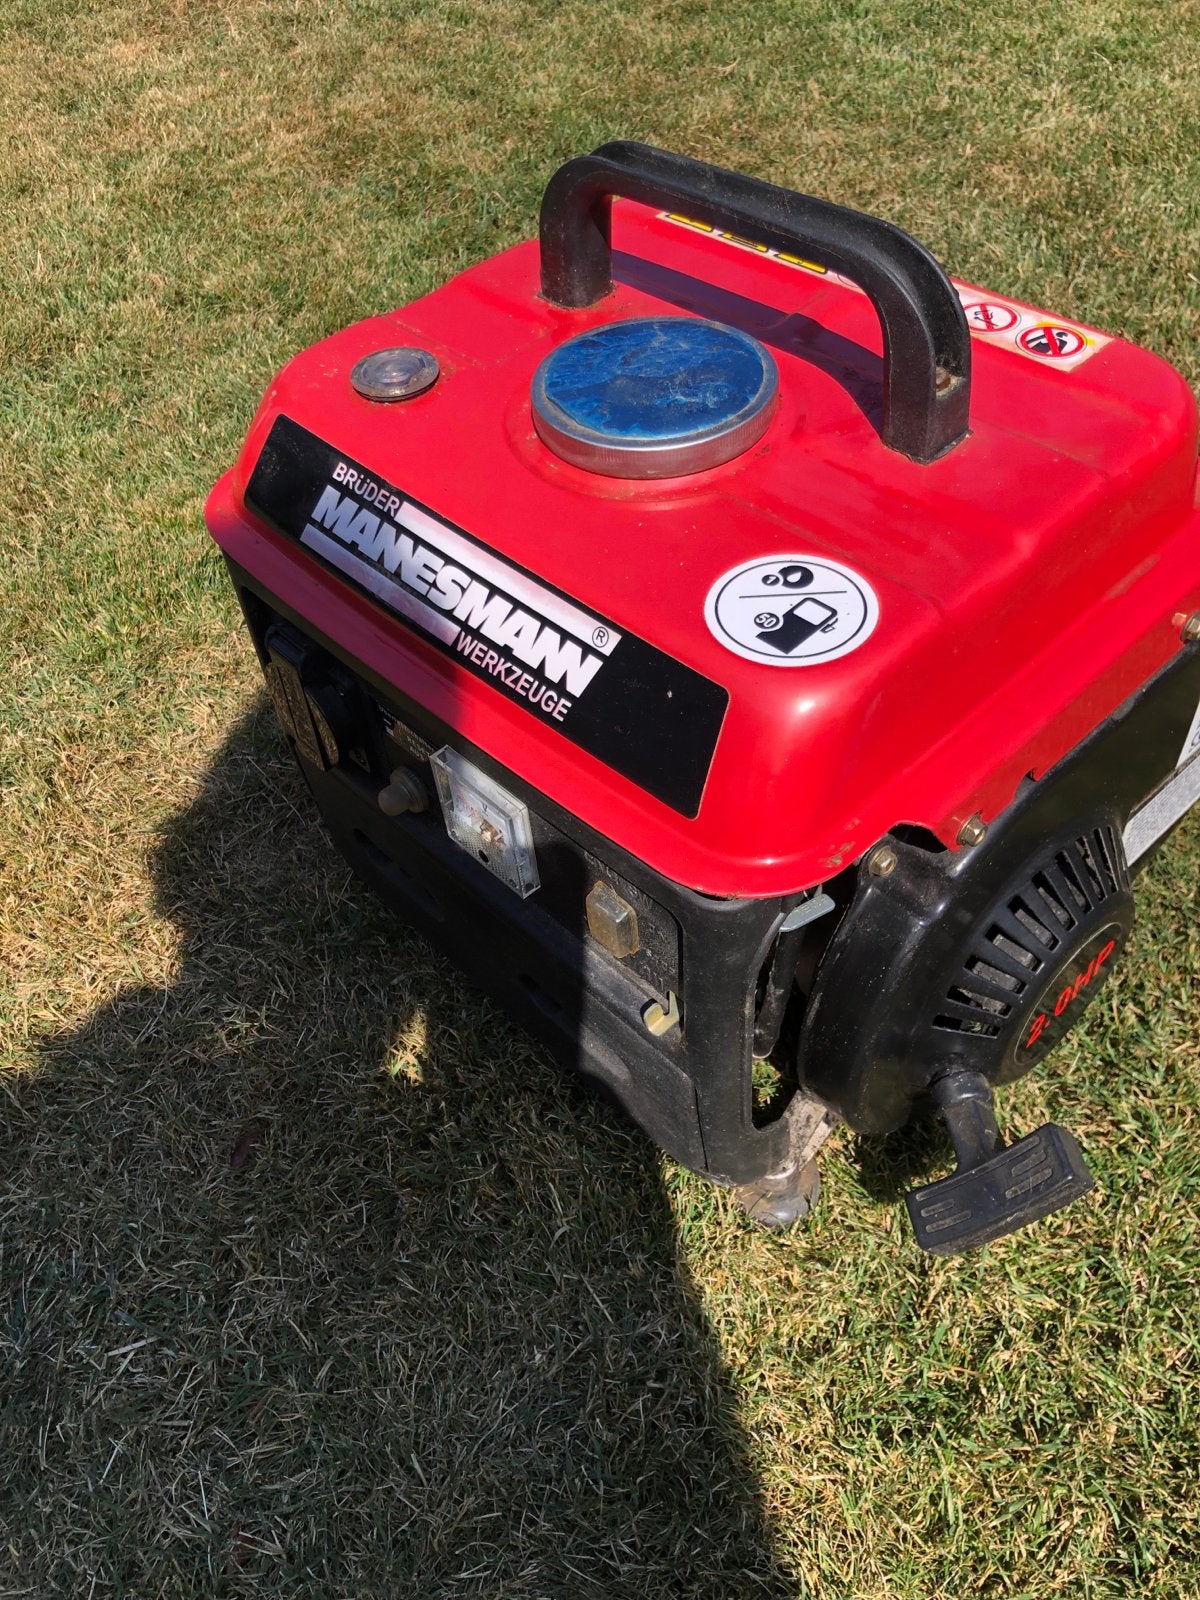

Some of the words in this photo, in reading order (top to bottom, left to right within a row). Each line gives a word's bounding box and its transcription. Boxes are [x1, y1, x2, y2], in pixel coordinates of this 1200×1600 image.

[311, 484, 603, 698] MANNESMANN
[755, 613, 777, 628] 50
[456, 631, 572, 722] WERKZEUGE
